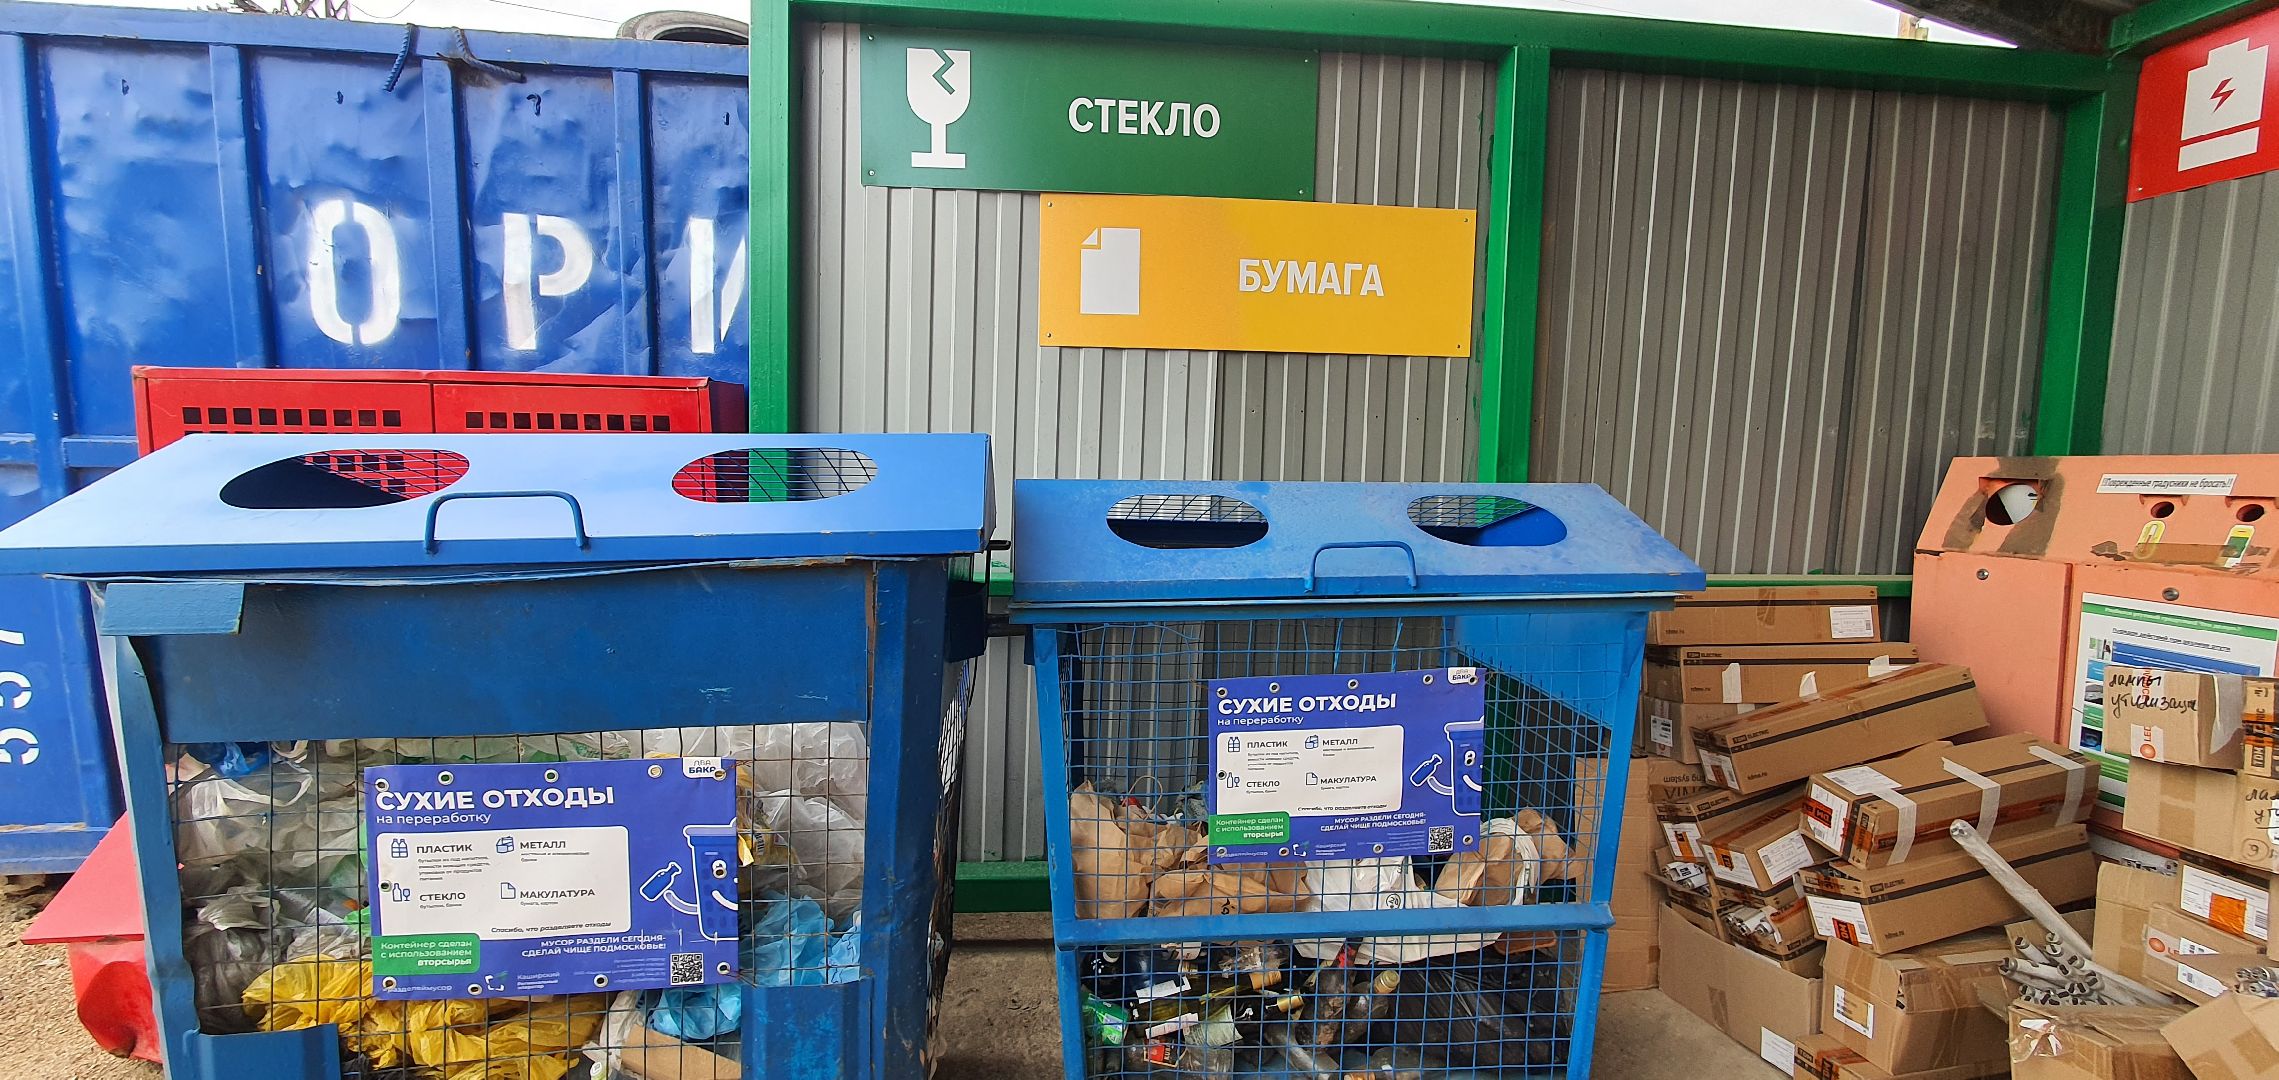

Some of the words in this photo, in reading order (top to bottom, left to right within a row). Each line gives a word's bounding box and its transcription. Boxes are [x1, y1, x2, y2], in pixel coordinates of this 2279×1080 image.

[1067, 96, 1221, 138] СТЕКЛО
[1238, 258, 1385, 298] БУМАГА
[1218, 697, 1293, 715] СУХИЕ
[1298, 693, 1397, 713] ОТХОДЫ
[1217, 718, 1231, 726] на
[1233, 716, 1304, 727] переработку
[1247, 740, 1288, 749] ПЛАСТИК
[1322, 738, 1358, 746] МЕТАЛЛ
[1246, 780, 1280, 788] СТЕКЛО
[1320, 775, 1377, 785] МАКУЛАТУРА
[376, 790, 475, 811] СУХИЕ
[482, 786, 614, 810] ОТХОДЫ
[376, 815, 393, 824] на
[396, 812, 492, 827] переработку
[1216, 819, 1256, 827] Контейнер
[1334, 816, 1360, 824] МУСОР
[1360, 814, 1392, 822] РАЗДЕЛИ
[1222, 824, 1284, 832] использованием
[1321, 823, 1349, 832] СДЕЛАЙ
[1350, 822, 1371, 830] ЧИЩЕ
[1243, 831, 1284, 839] вторсырья
[416, 844, 473, 854] ПЛАСТИК
[520, 840, 567, 850] МЕТАЛЛ
[419, 892, 466, 902] СТЕКЛО
[520, 888, 596, 899] МАКУЛАТУРА
[381, 941, 436, 950] Контейнер
[437, 940, 472, 948] сделан
[540, 938, 575, 948] МУСОР
[576, 936, 619, 946] РАЗДЕЛИ
[621, 934, 666, 944] СЕГОДНЯ-
[388, 949, 472, 958] использованием
[522, 946, 561, 957] СДЕЛАЙ
[563, 945, 592, 955] ЧИЩЕ
[593, 943, 667, 953] ПОДМОСКОВЬЕ!
[417, 958, 472, 967] вторсырья
